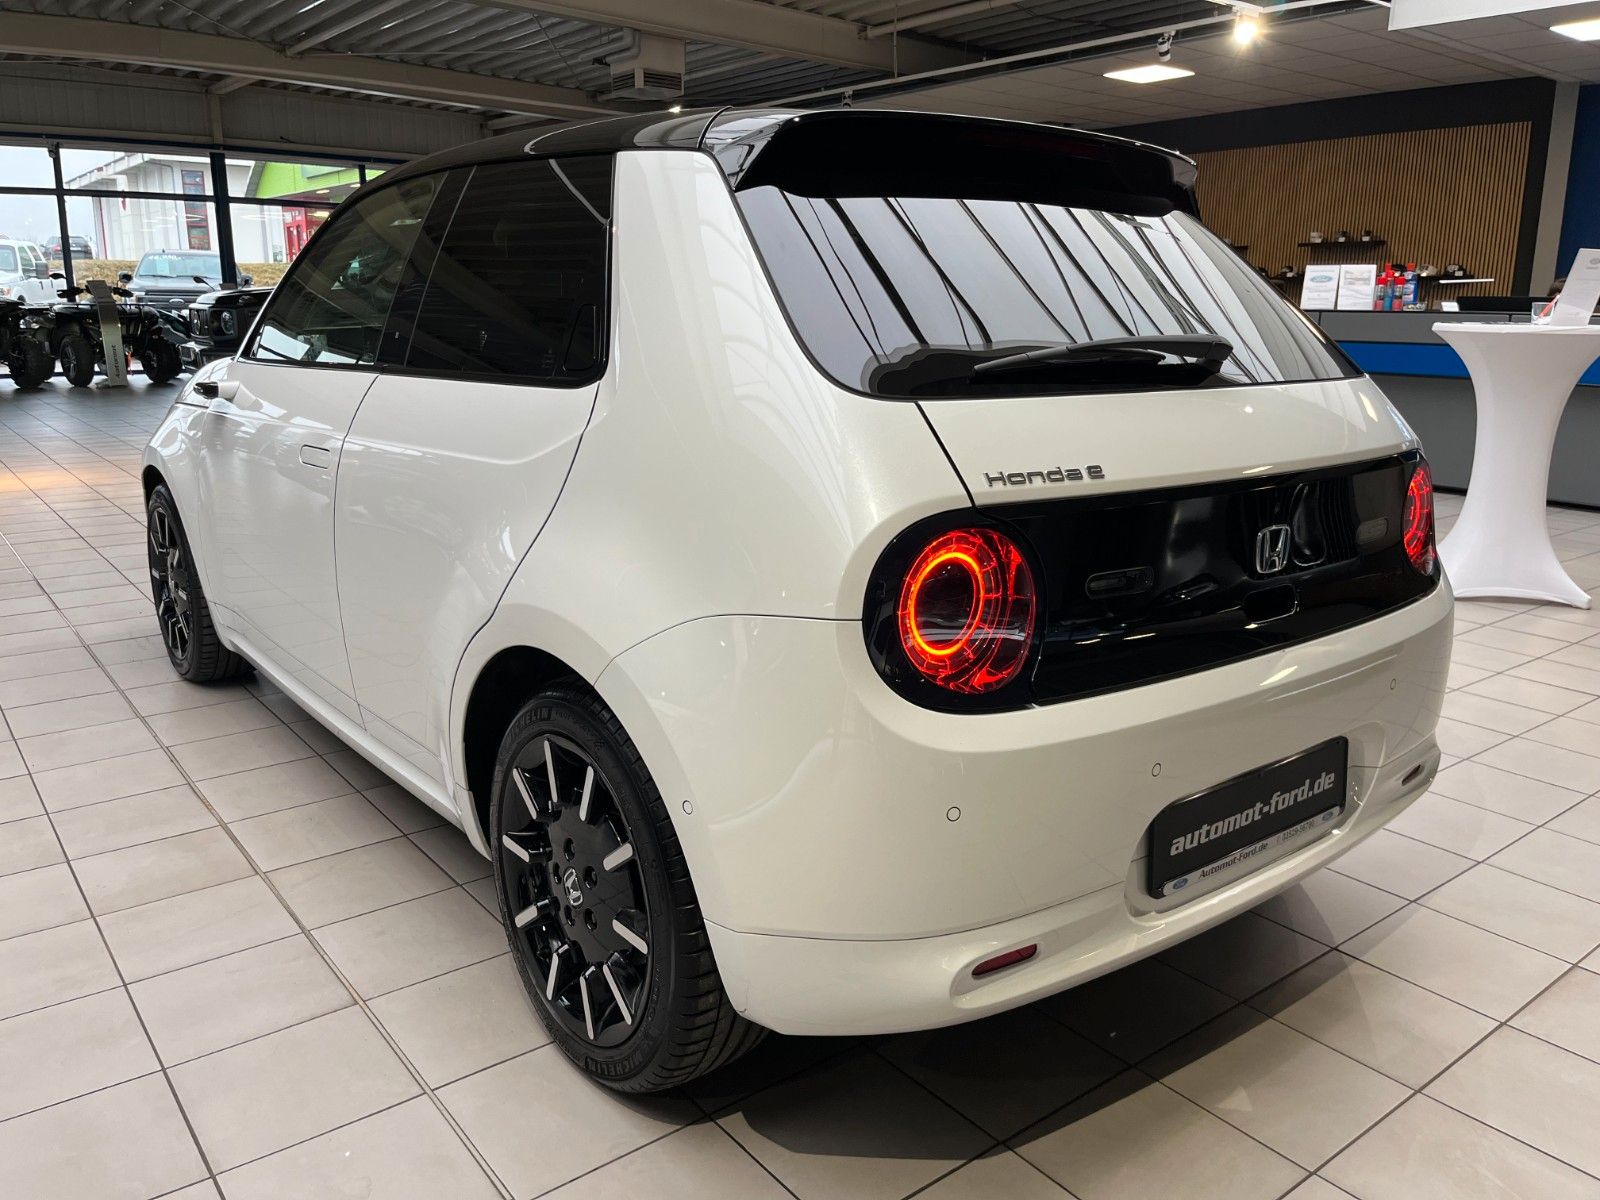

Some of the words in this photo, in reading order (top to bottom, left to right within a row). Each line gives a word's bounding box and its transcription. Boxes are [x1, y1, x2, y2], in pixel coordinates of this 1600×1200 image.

[984, 466, 1083, 487] Honda
[1085, 464, 1105, 480] e
[1169, 771, 1335, 856] automot-ford.de
[1199, 842, 1269, 879] Automot-Ford.de
